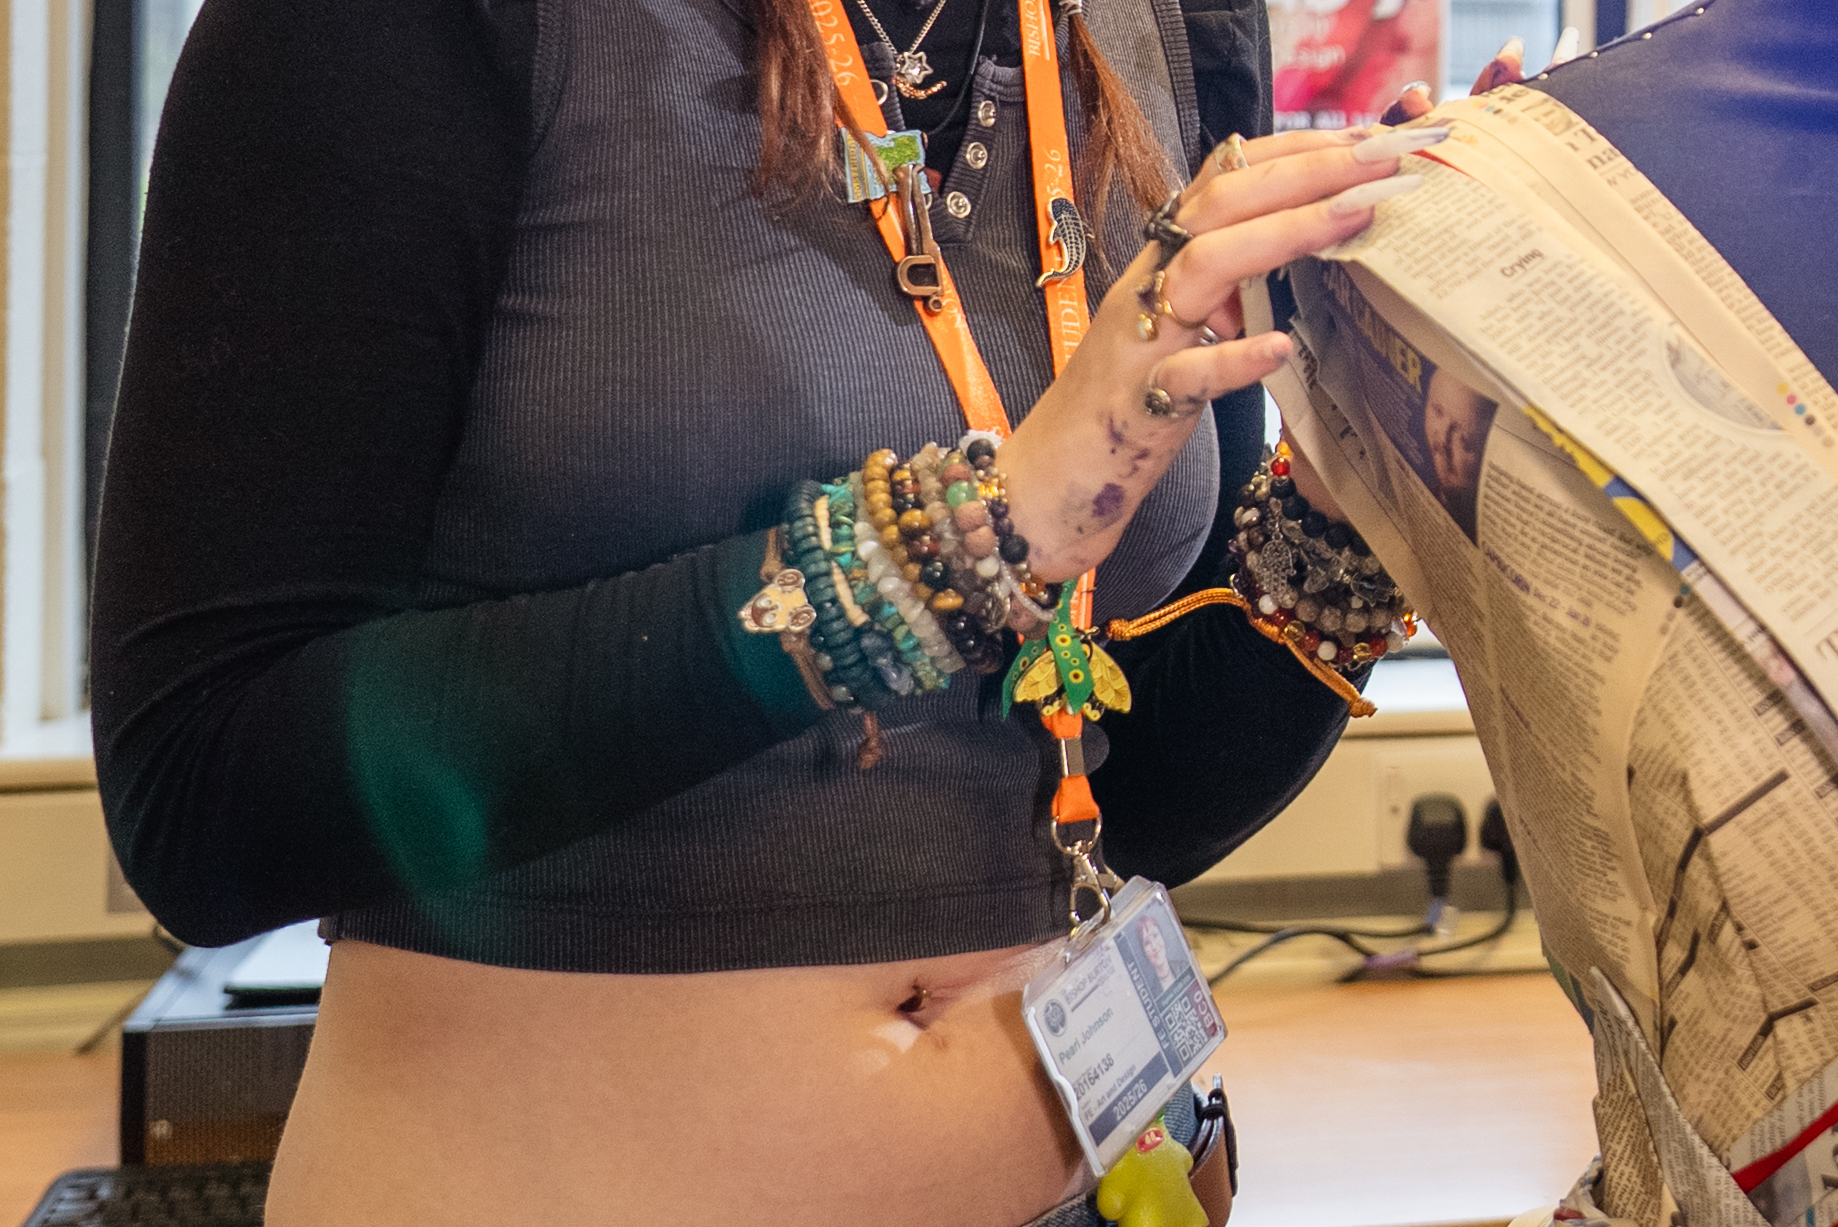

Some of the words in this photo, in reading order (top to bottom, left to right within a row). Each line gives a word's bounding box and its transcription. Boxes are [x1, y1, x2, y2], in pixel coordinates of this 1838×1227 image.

[1500, 246, 1545, 279] Crying
[1127, 961, 1161, 1028] STUDENT
[1059, 1038, 1082, 1065] Pearl
[1081, 1007, 1114, 1046] Johnson
[1157, 1028, 1171, 1050] FE
[1113, 1078, 1148, 1121] 2025/26
